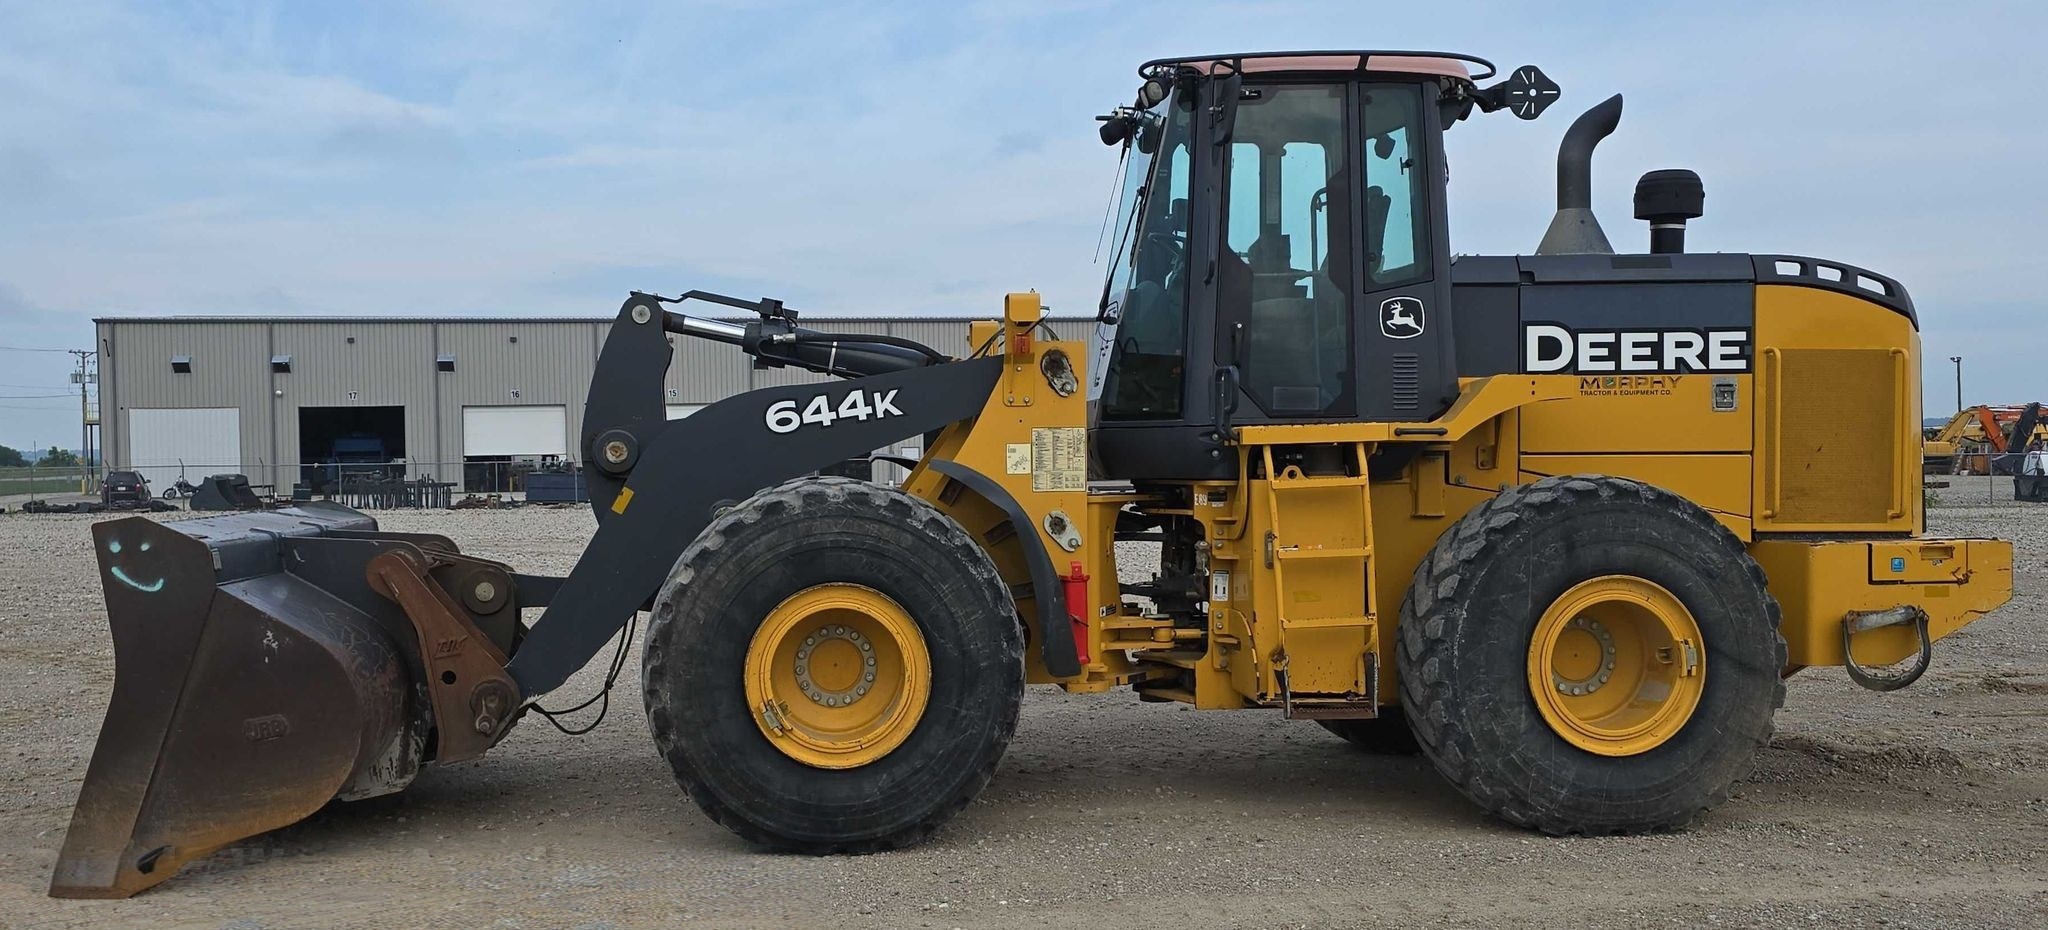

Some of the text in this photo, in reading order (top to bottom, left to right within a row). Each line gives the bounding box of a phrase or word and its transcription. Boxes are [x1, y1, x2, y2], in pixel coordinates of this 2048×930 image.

[1526, 325, 1747, 372] DEERE
[1580, 376, 1683, 389] MURPHY
[348, 391, 357, 400] 17
[511, 390, 520, 398] 16
[669, 389, 677, 397] 15
[765, 389, 904, 433] 644K
